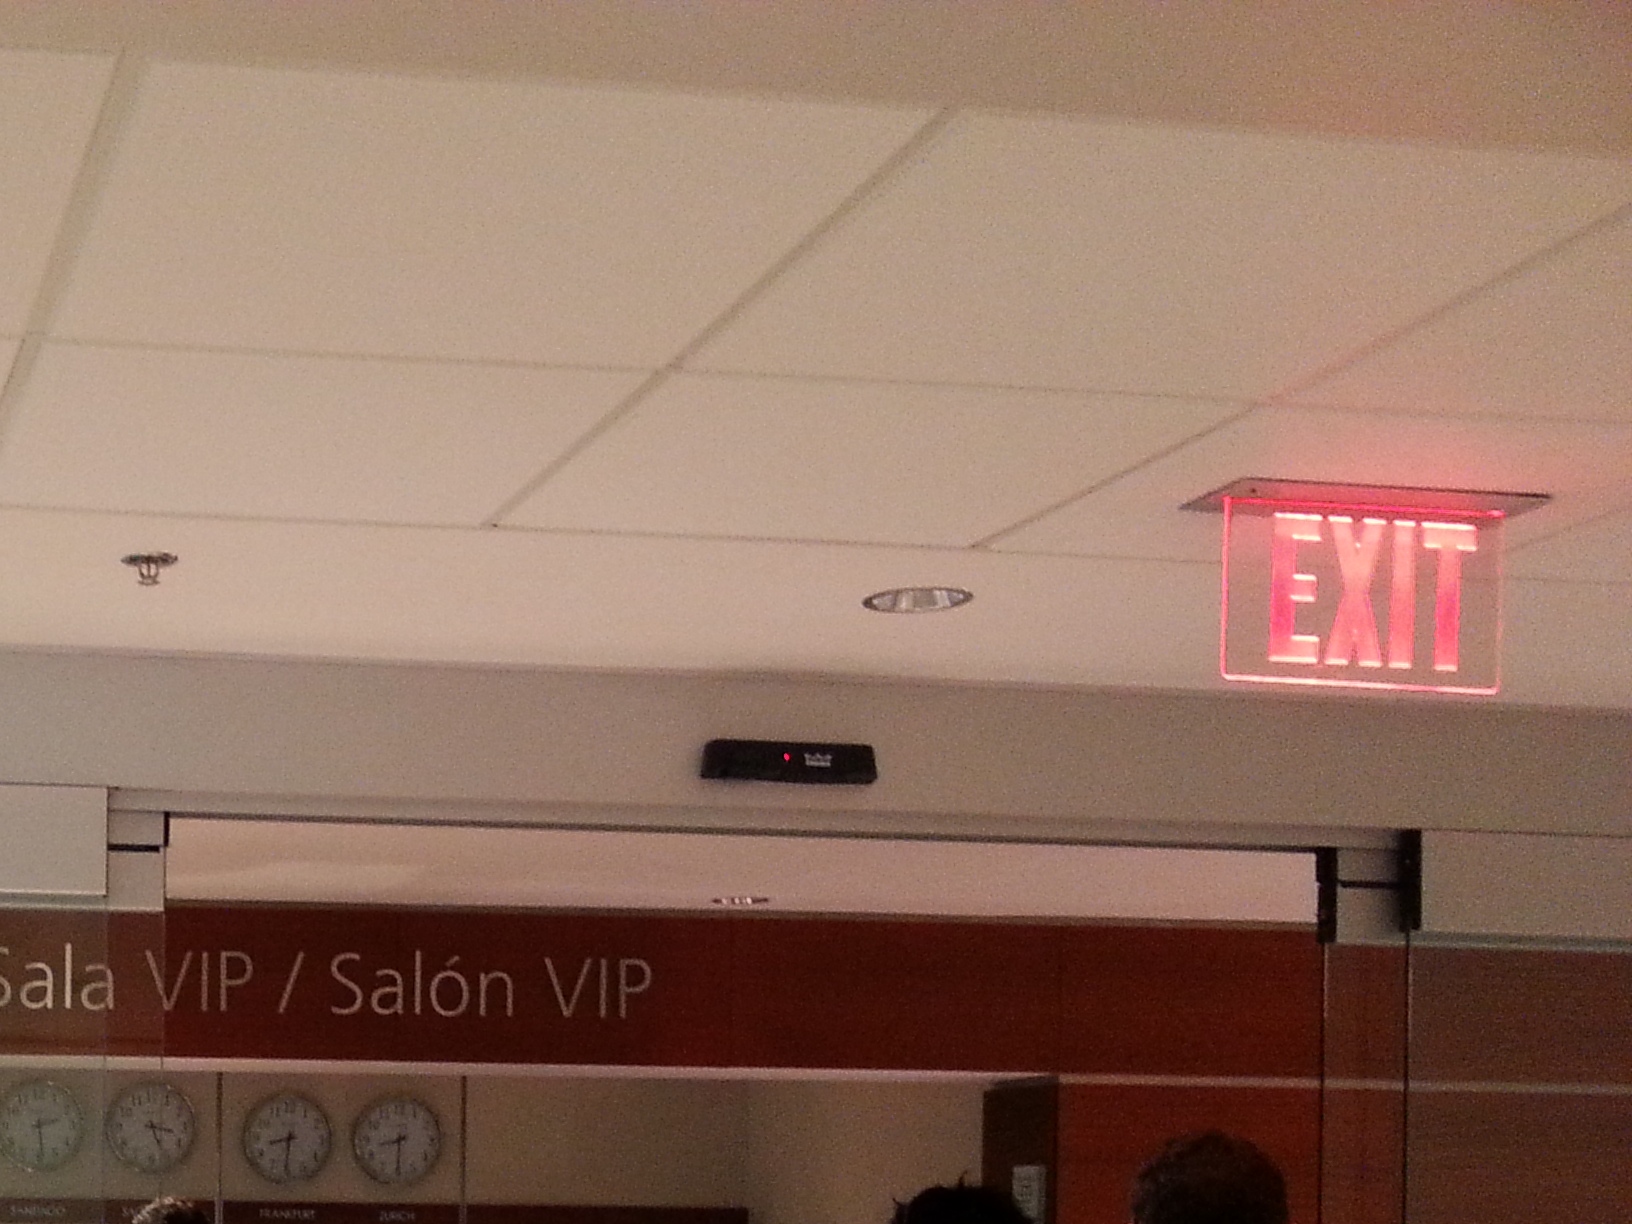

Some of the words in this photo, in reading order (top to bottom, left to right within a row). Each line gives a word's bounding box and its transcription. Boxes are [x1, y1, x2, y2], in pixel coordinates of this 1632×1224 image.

[1269, 513, 1478, 671] EXIT
[144, 948, 254, 1013] VIP
[277, 951, 306, 1015] /
[329, 949, 514, 1018] Salón
[544, 957, 653, 1020] VIP
